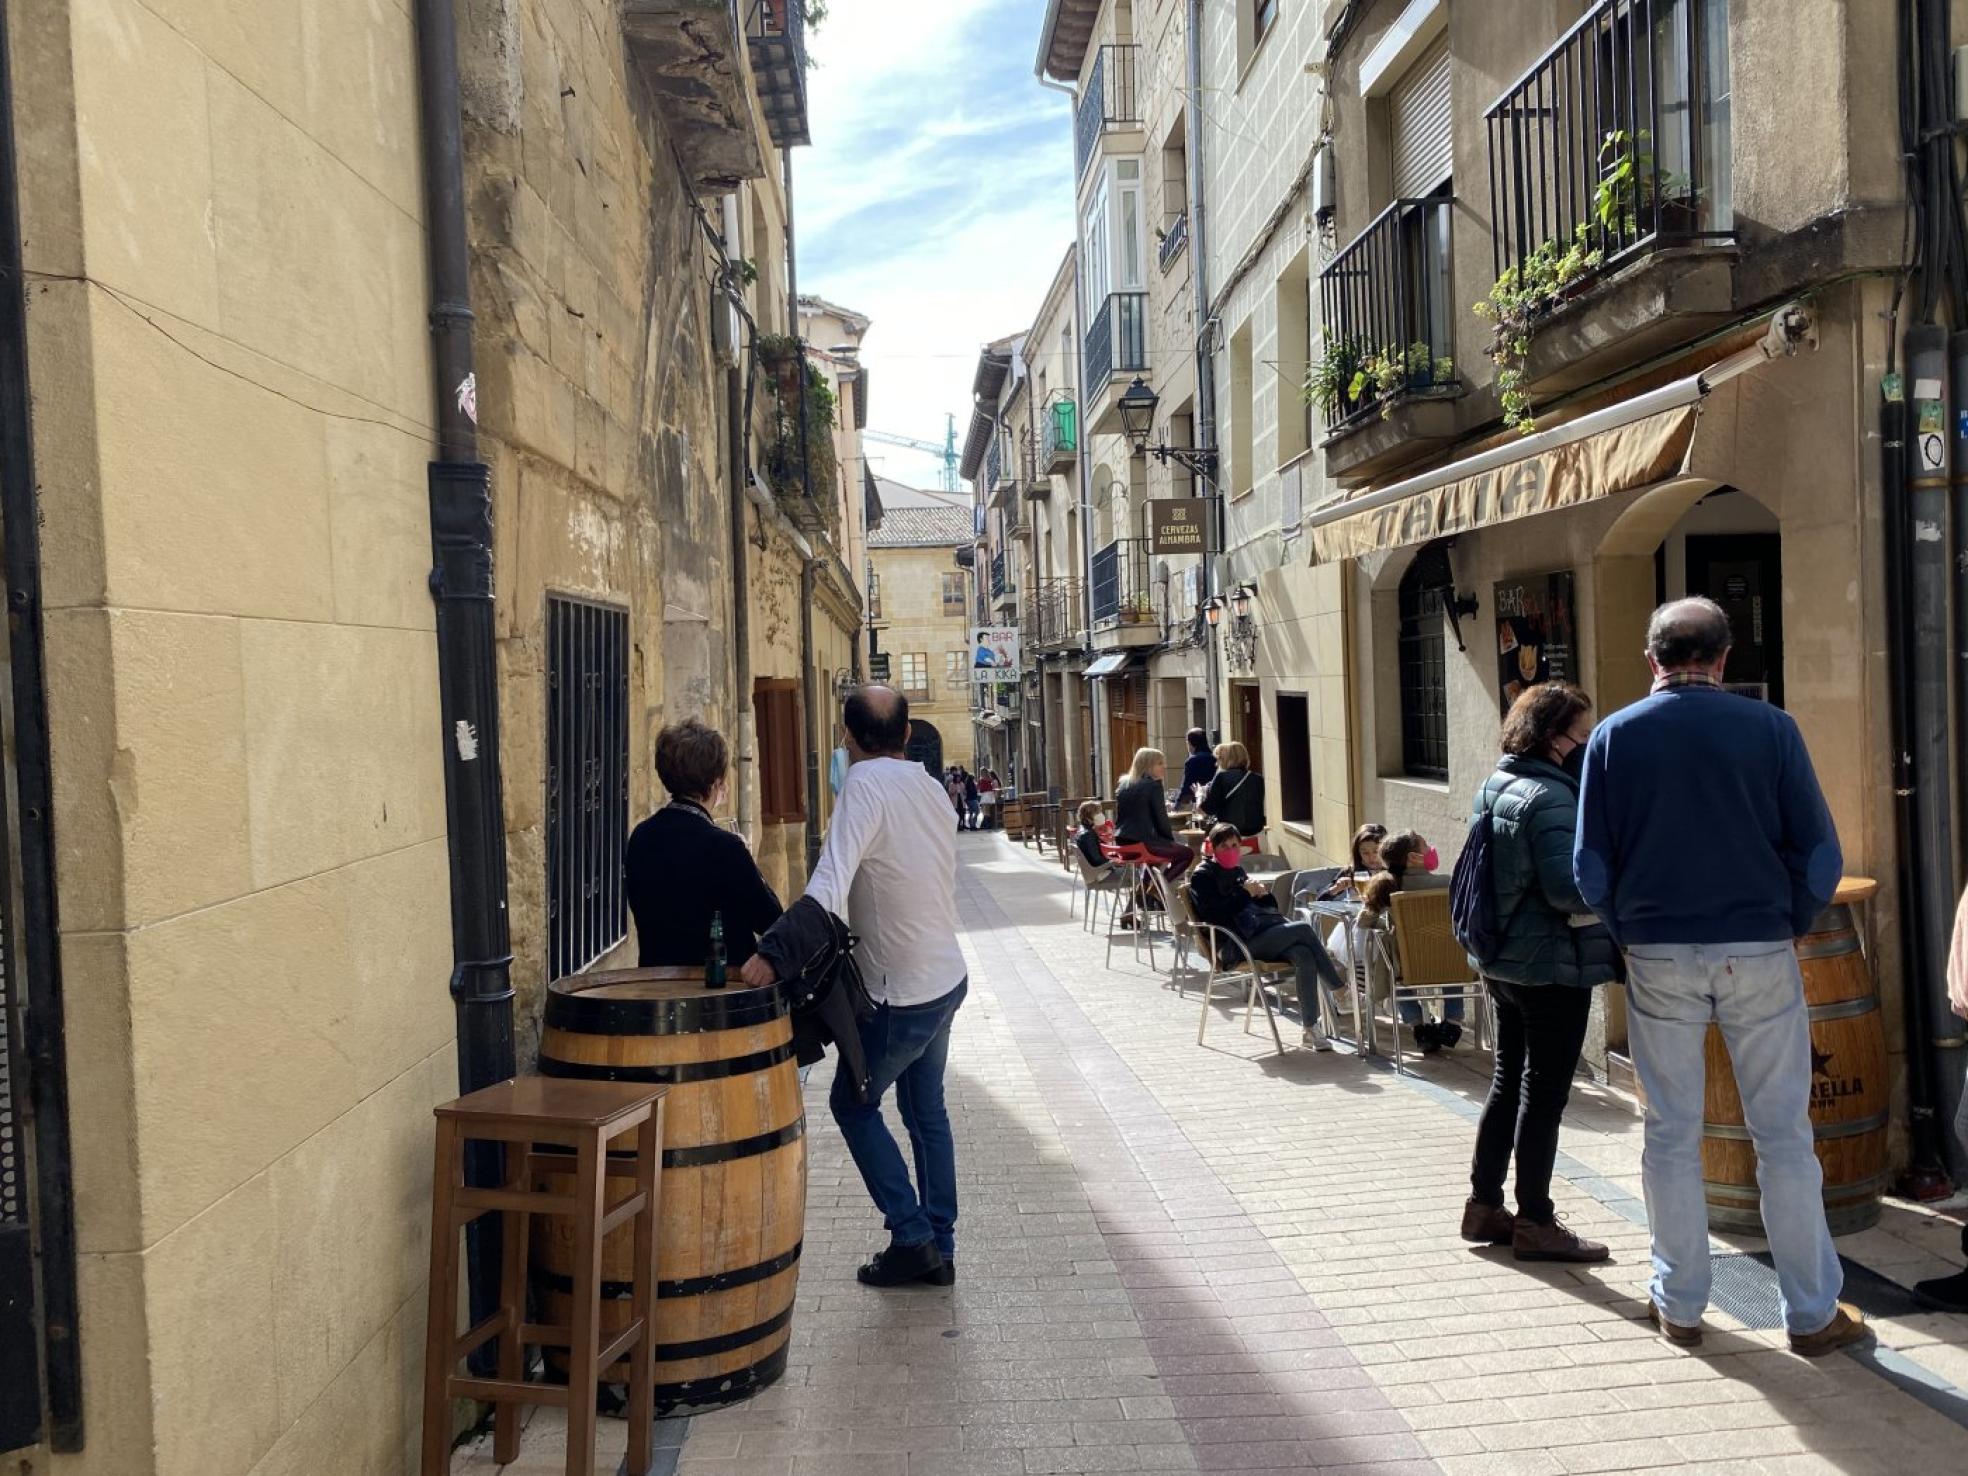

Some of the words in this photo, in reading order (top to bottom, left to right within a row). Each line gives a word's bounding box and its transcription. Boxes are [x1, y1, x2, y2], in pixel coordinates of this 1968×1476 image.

[1160, 524, 1198, 534] CERVEZAS
[1159, 535, 1201, 544] ALHAMBRA
[1498, 585, 1527, 617] BAR
[992, 631, 1013, 641] BAR
[974, 670, 988, 680] LA
[995, 669, 1017, 680] KIKA
